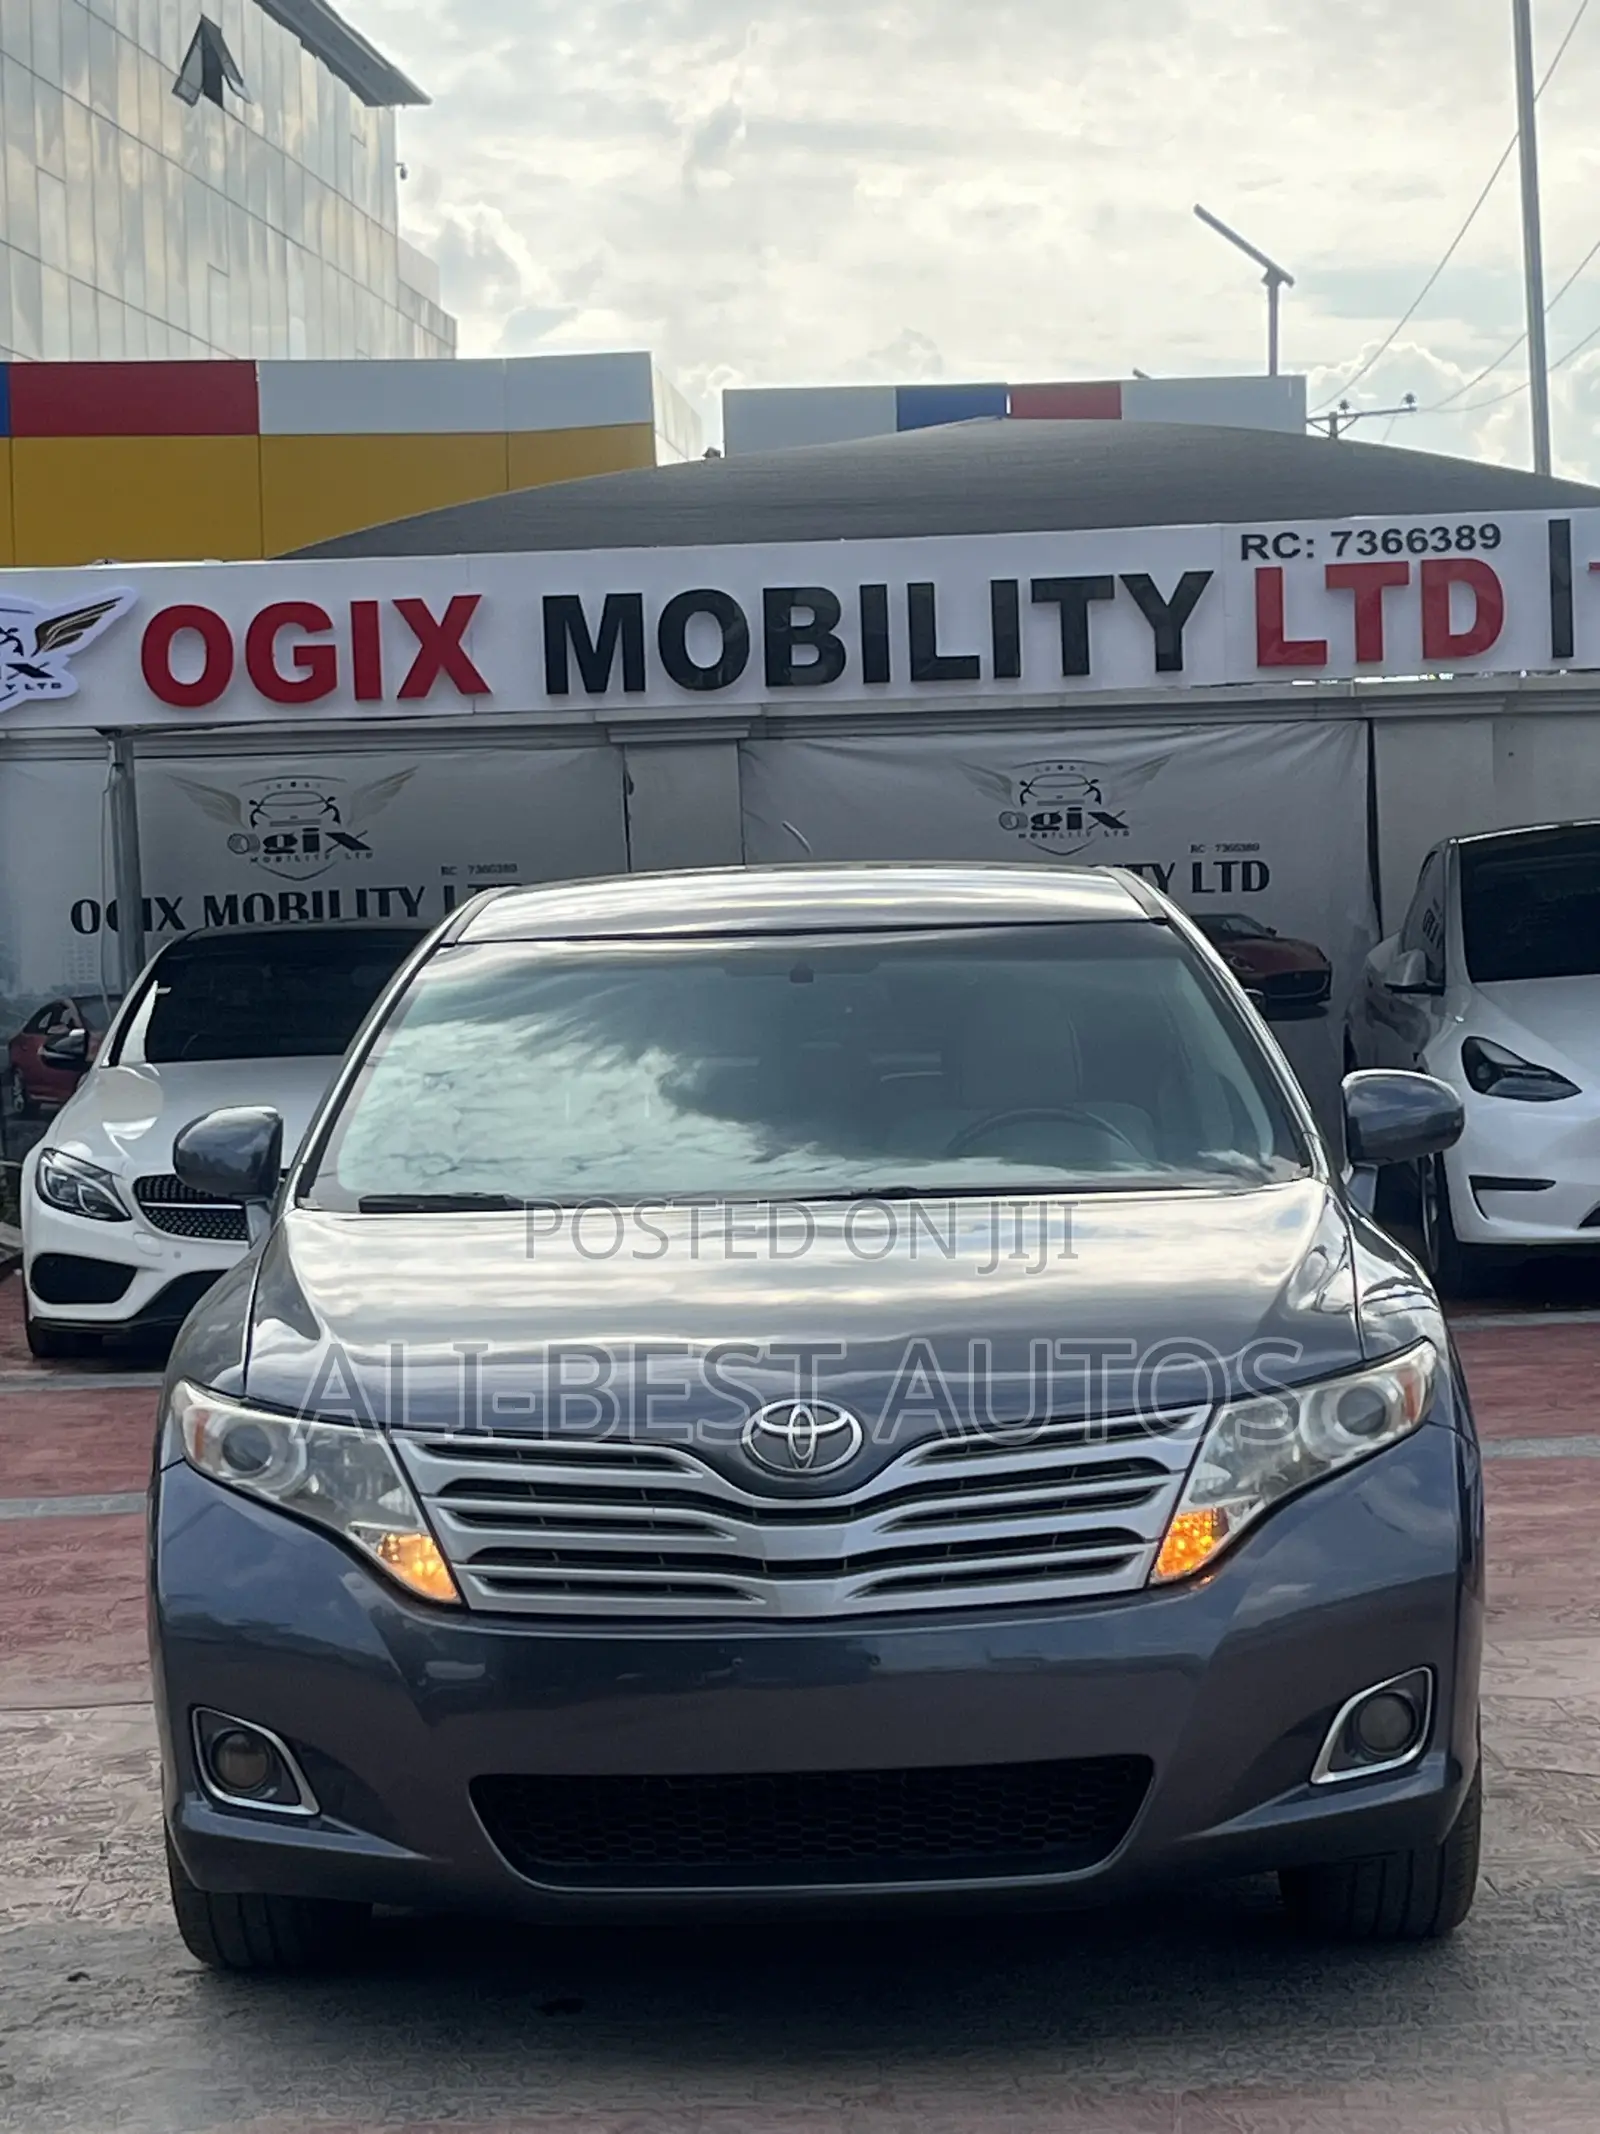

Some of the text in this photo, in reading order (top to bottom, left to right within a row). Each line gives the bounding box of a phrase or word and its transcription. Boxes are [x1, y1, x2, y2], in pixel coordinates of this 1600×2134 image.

[1240, 522, 1502, 561] RC: 7366389
[140, 557, 1506, 708] OGIX MOBILITY LTD
[1191, 860, 1271, 894] LTD
[70, 896, 187, 935] OIX
